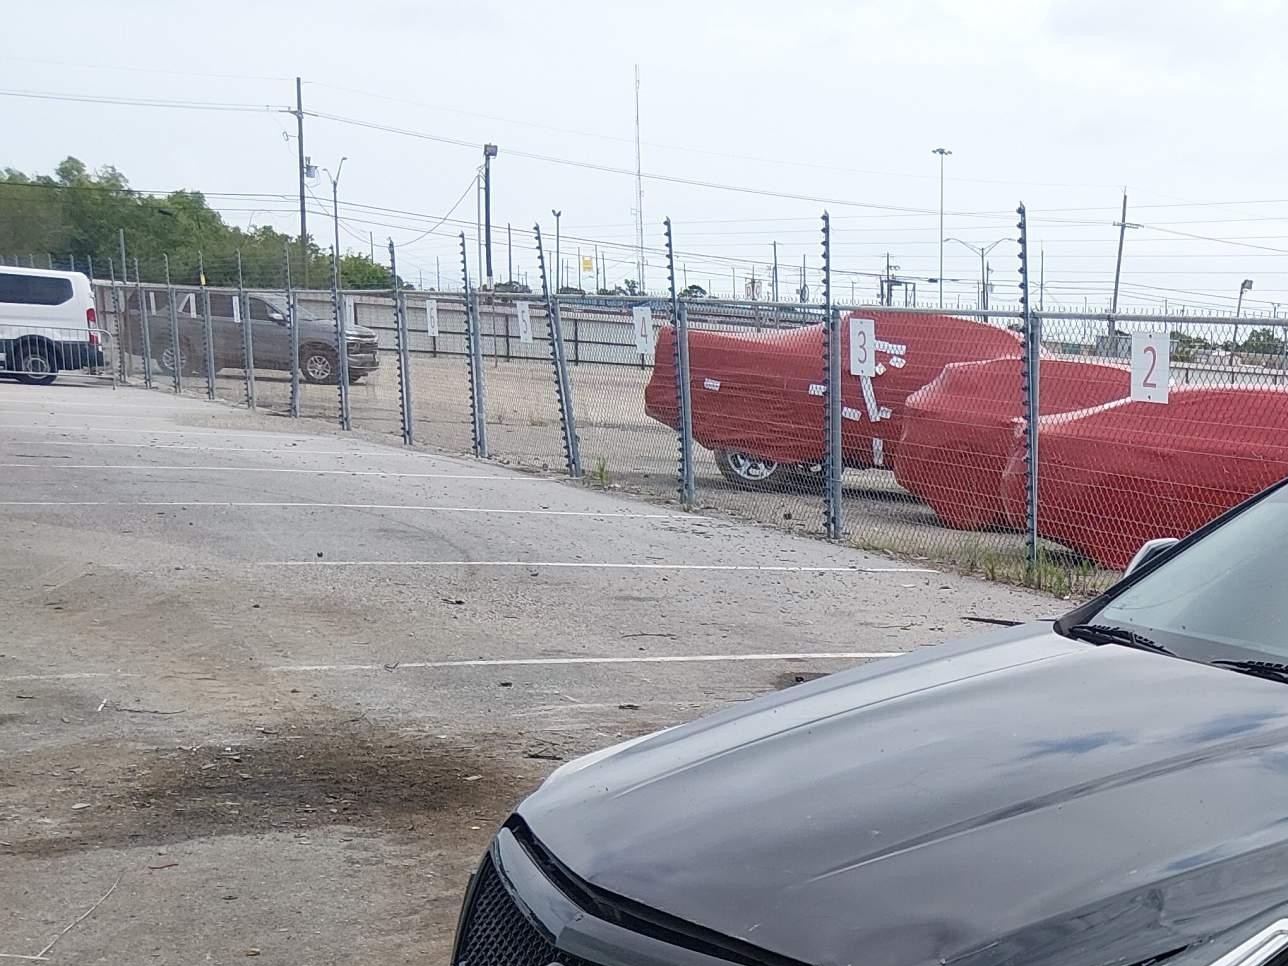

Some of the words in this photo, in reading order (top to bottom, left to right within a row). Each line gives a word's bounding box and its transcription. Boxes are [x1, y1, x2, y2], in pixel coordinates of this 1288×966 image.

[521, 310, 528, 334] 5
[640, 316, 648, 344] 4
[857, 330, 867, 364] 3
[1142, 345, 1157, 389] 2
